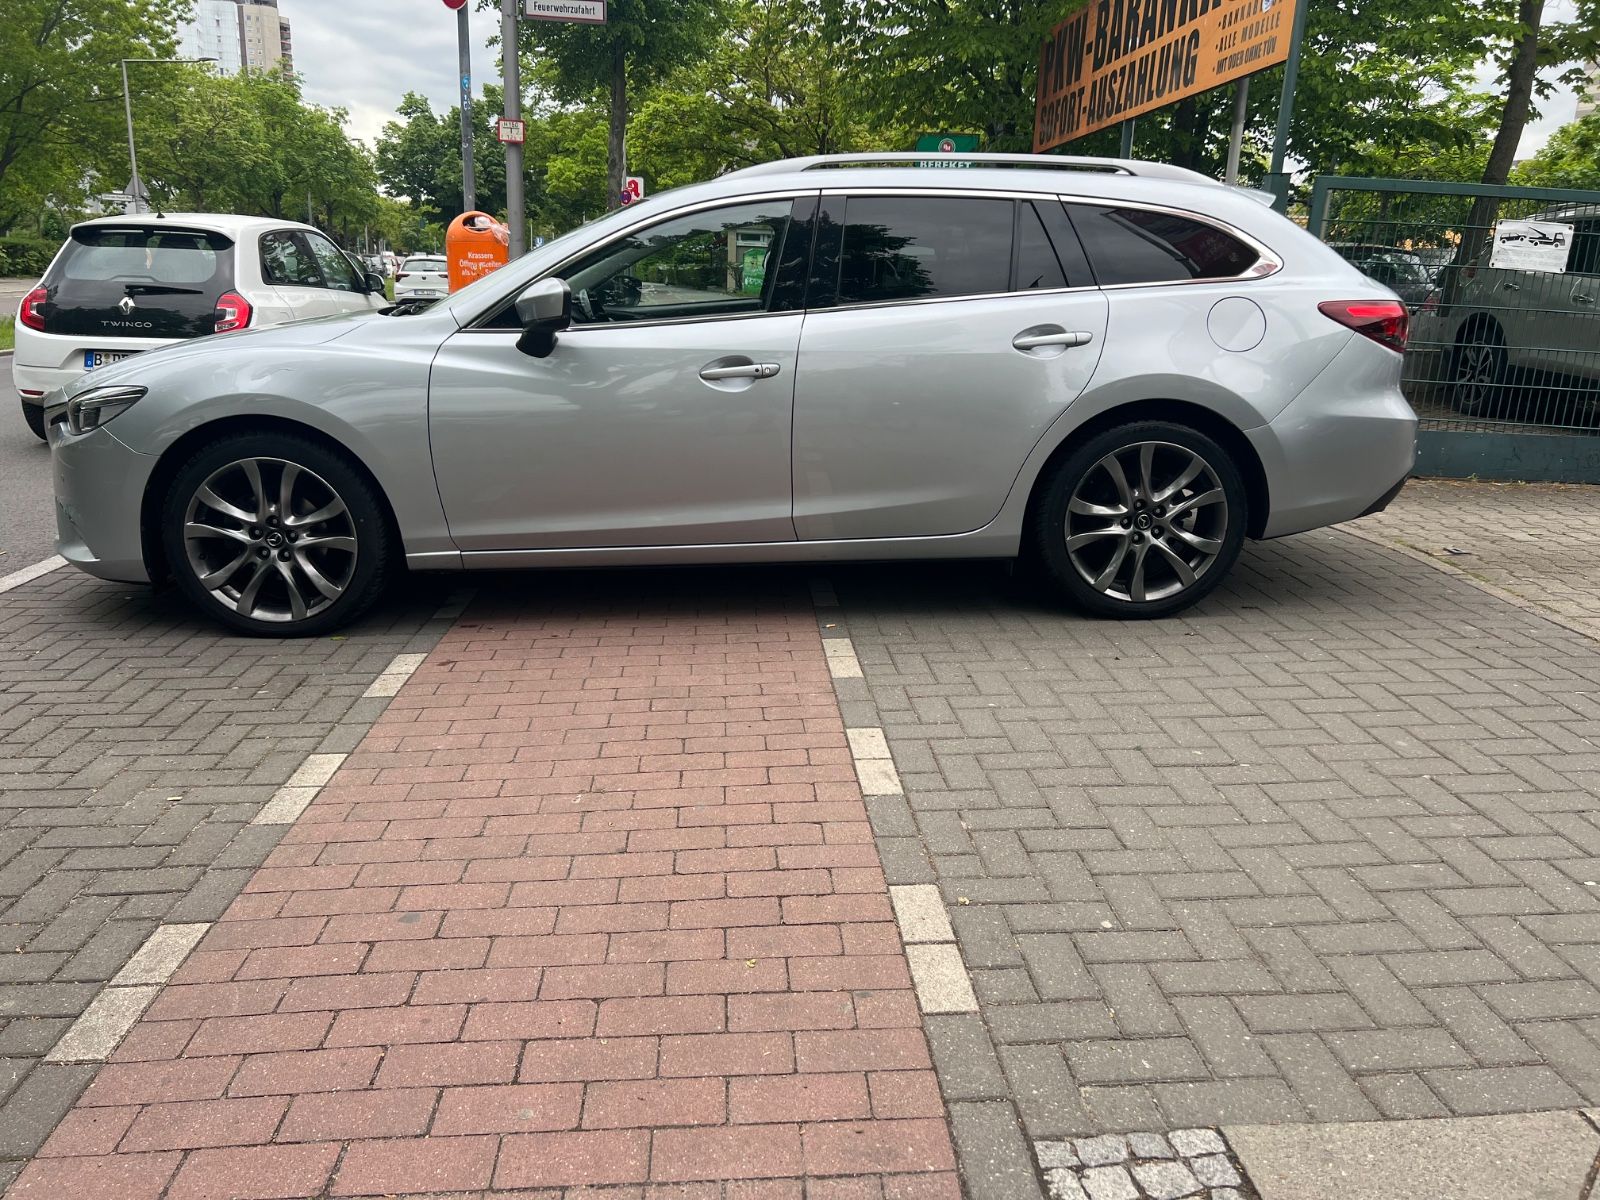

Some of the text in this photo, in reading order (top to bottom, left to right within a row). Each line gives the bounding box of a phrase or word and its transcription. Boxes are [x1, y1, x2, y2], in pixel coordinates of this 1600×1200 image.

[533, 1, 595, 15] Feuerwehrzufahrt
[1218, 11, 1281, 53] ALLE MODELLE
[1042, 0, 1236, 98] PKW-BARA
[1216, 35, 1278, 75] MIT ODER OHNE TÜV
[1039, 28, 1200, 146] SOFORT-AUSZAHLUNG
[920, 160, 972, 168] BEREKET
[467, 251, 494, 259] Krassere
[101, 320, 153, 328] TWINGO
[95, 353, 102, 366] B
